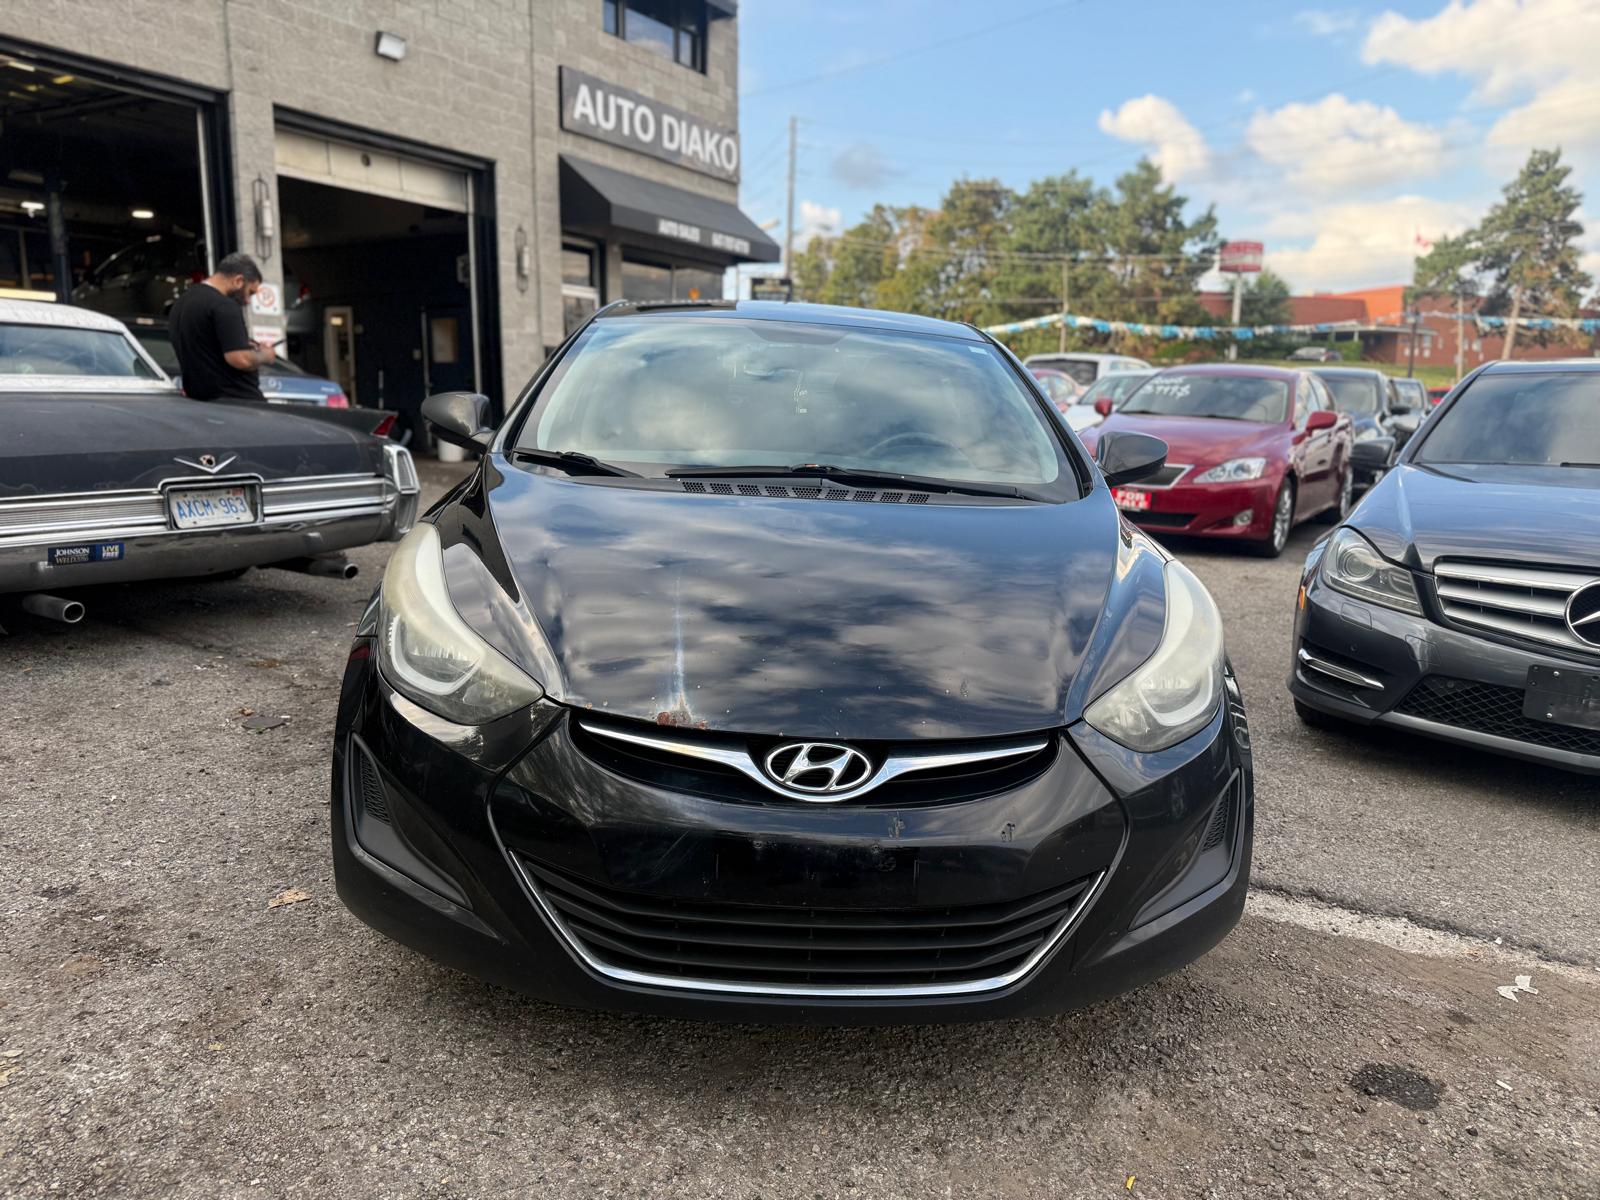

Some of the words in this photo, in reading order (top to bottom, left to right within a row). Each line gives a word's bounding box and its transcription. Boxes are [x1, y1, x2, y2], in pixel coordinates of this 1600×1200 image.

[573, 83, 655, 142] AUTO
[662, 114, 738, 170] DIAKO
[1116, 490, 1145, 500] FOR
[176, 498, 214, 520] AXCM
[218, 497, 247, 514] 963
[54, 548, 90, 557] JOHNSON
